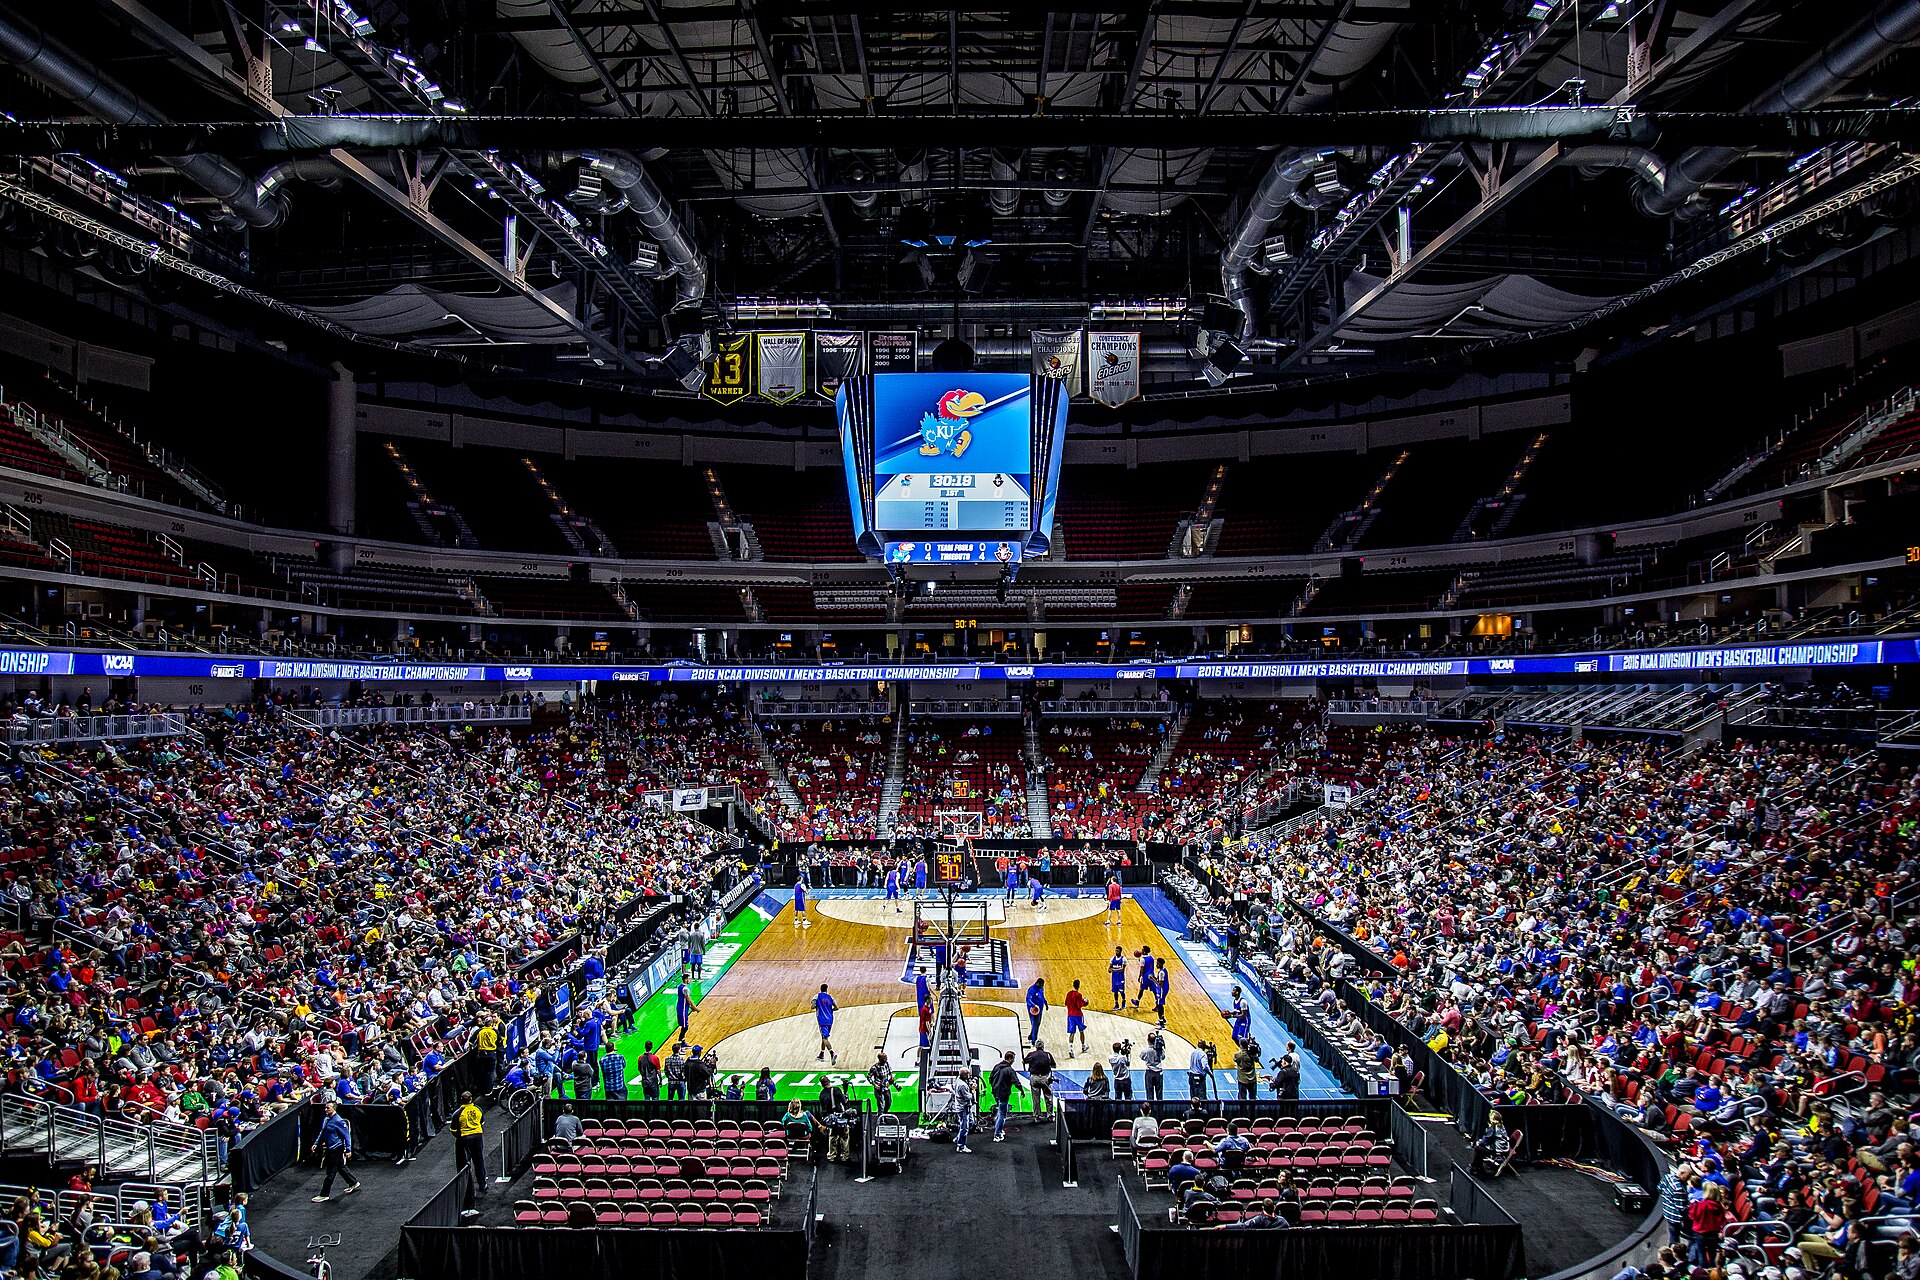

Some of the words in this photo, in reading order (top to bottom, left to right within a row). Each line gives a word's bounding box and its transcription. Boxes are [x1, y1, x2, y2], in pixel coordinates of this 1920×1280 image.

[1091, 342, 1137, 350] CHAMPIONS
[712, 353, 741, 385] 13
[1097, 361, 1131, 380] ENERGY
[710, 387, 743, 395] WARNER
[936, 425, 954, 439] KU
[1310, 433, 1326, 441] 314
[24, 491, 43, 504] 205
[1743, 511, 1758, 522] 216
[171, 522, 185, 533] 206
[924, 543, 931, 552] 0
[979, 543, 986, 552] 0
[1558, 542, 1575, 551] 215
[359, 550, 375, 559] 207
[924, 552, 931, 561] 4
[978, 552, 985, 561] 4
[1390, 557, 1407, 565] 214
[1247, 565, 1264, 573] 213
[955, 620, 977, 629] 30:19
[105, 655, 134, 670] NCAA
[1622, 655, 1639, 670] 2016
[1640, 654, 1658, 669] NCAA
[1659, 652, 1690, 668] DIVISION
[1690, 652, 1696, 667] I
[1696, 650, 1722, 667] MEN'S
[1723, 648, 1777, 666] BASKETBALL
[1779, 645, 1858, 665] CHAMPIONSHIP
[1198, 666, 1222, 677] 2016
[1224, 665, 1250, 677] NCAA
[1251, 665, 1292, 676] DIVISION
[1292, 665, 1297, 676] I
[1299, 664, 1327, 676] MEN'S
[1329, 664, 1385, 676] BASKETBALL
[1387, 662, 1453, 675] CHAMPIONSHIP
[1490, 659, 1514, 670] NCAA
[275, 662, 291, 677] 2016
[293, 663, 310, 678] NCAA
[311, 664, 337, 679] DIVISION
[338, 664, 342, 679] I
[341, 665, 359, 680] MEN'S
[360, 665, 402, 680] BASKETBALL
[404, 667, 469, 680] CHAMPIONSHIP
[505, 668, 531, 678] NCAA
[691, 669, 715, 680] 2016
[717, 669, 742, 680] NCAA
[744, 669, 786, 680] DIVISION
[786, 669, 791, 680] I
[794, 669, 822, 680] MEN'S
[825, 668, 883, 680] BASKETBALL
[884, 667, 960, 679] CHAMPIONSHIP
[1008, 667, 1034, 676] NCAA
[189, 685, 203, 696] 105
[449, 685, 463, 694] 107
[1093, 682, 1111, 690] 112
[955, 787, 967, 796] 30
[938, 854, 962, 864] 30:19
[941, 863, 959, 879] 30
